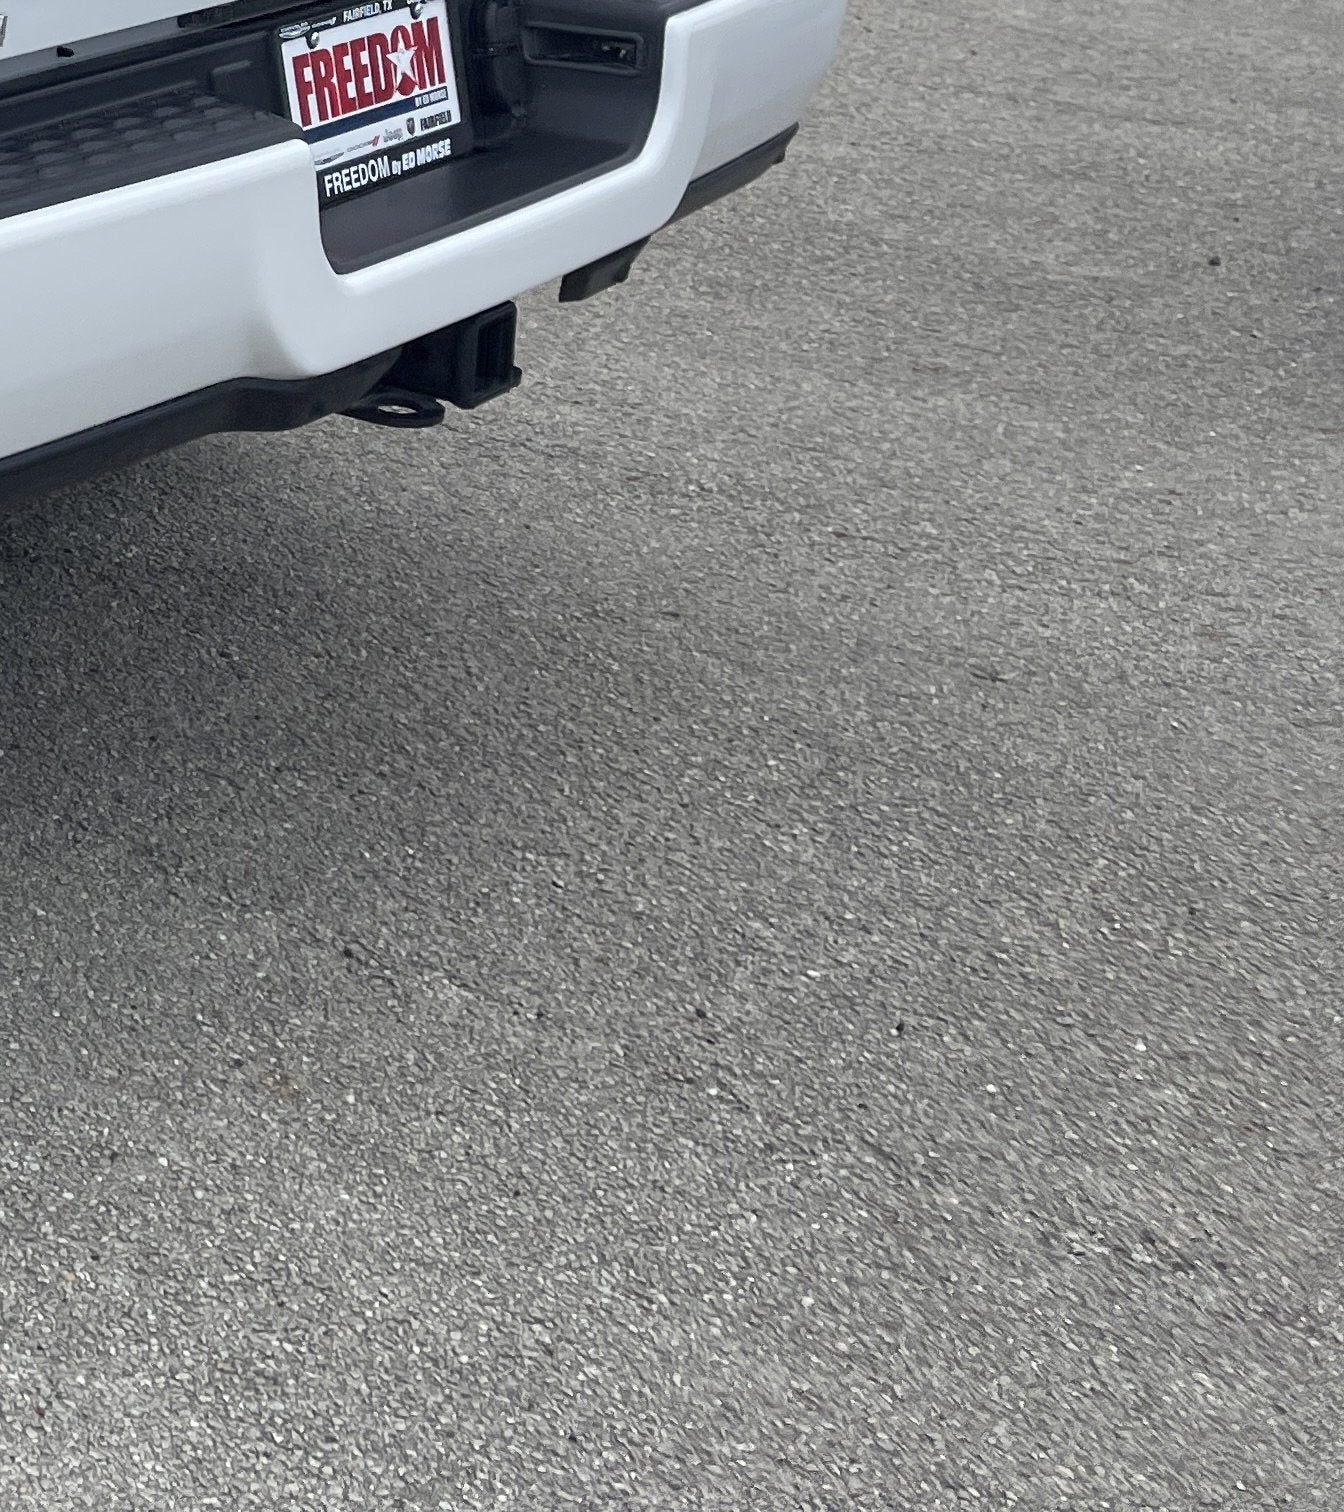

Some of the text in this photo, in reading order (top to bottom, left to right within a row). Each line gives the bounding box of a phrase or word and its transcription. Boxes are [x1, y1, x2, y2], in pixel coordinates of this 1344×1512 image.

[292, 16, 447, 128] FREEDOM
[324, 155, 391, 198] FREEDOM
[401, 150, 416, 170] ED
[415, 138, 452, 166] MORSE
